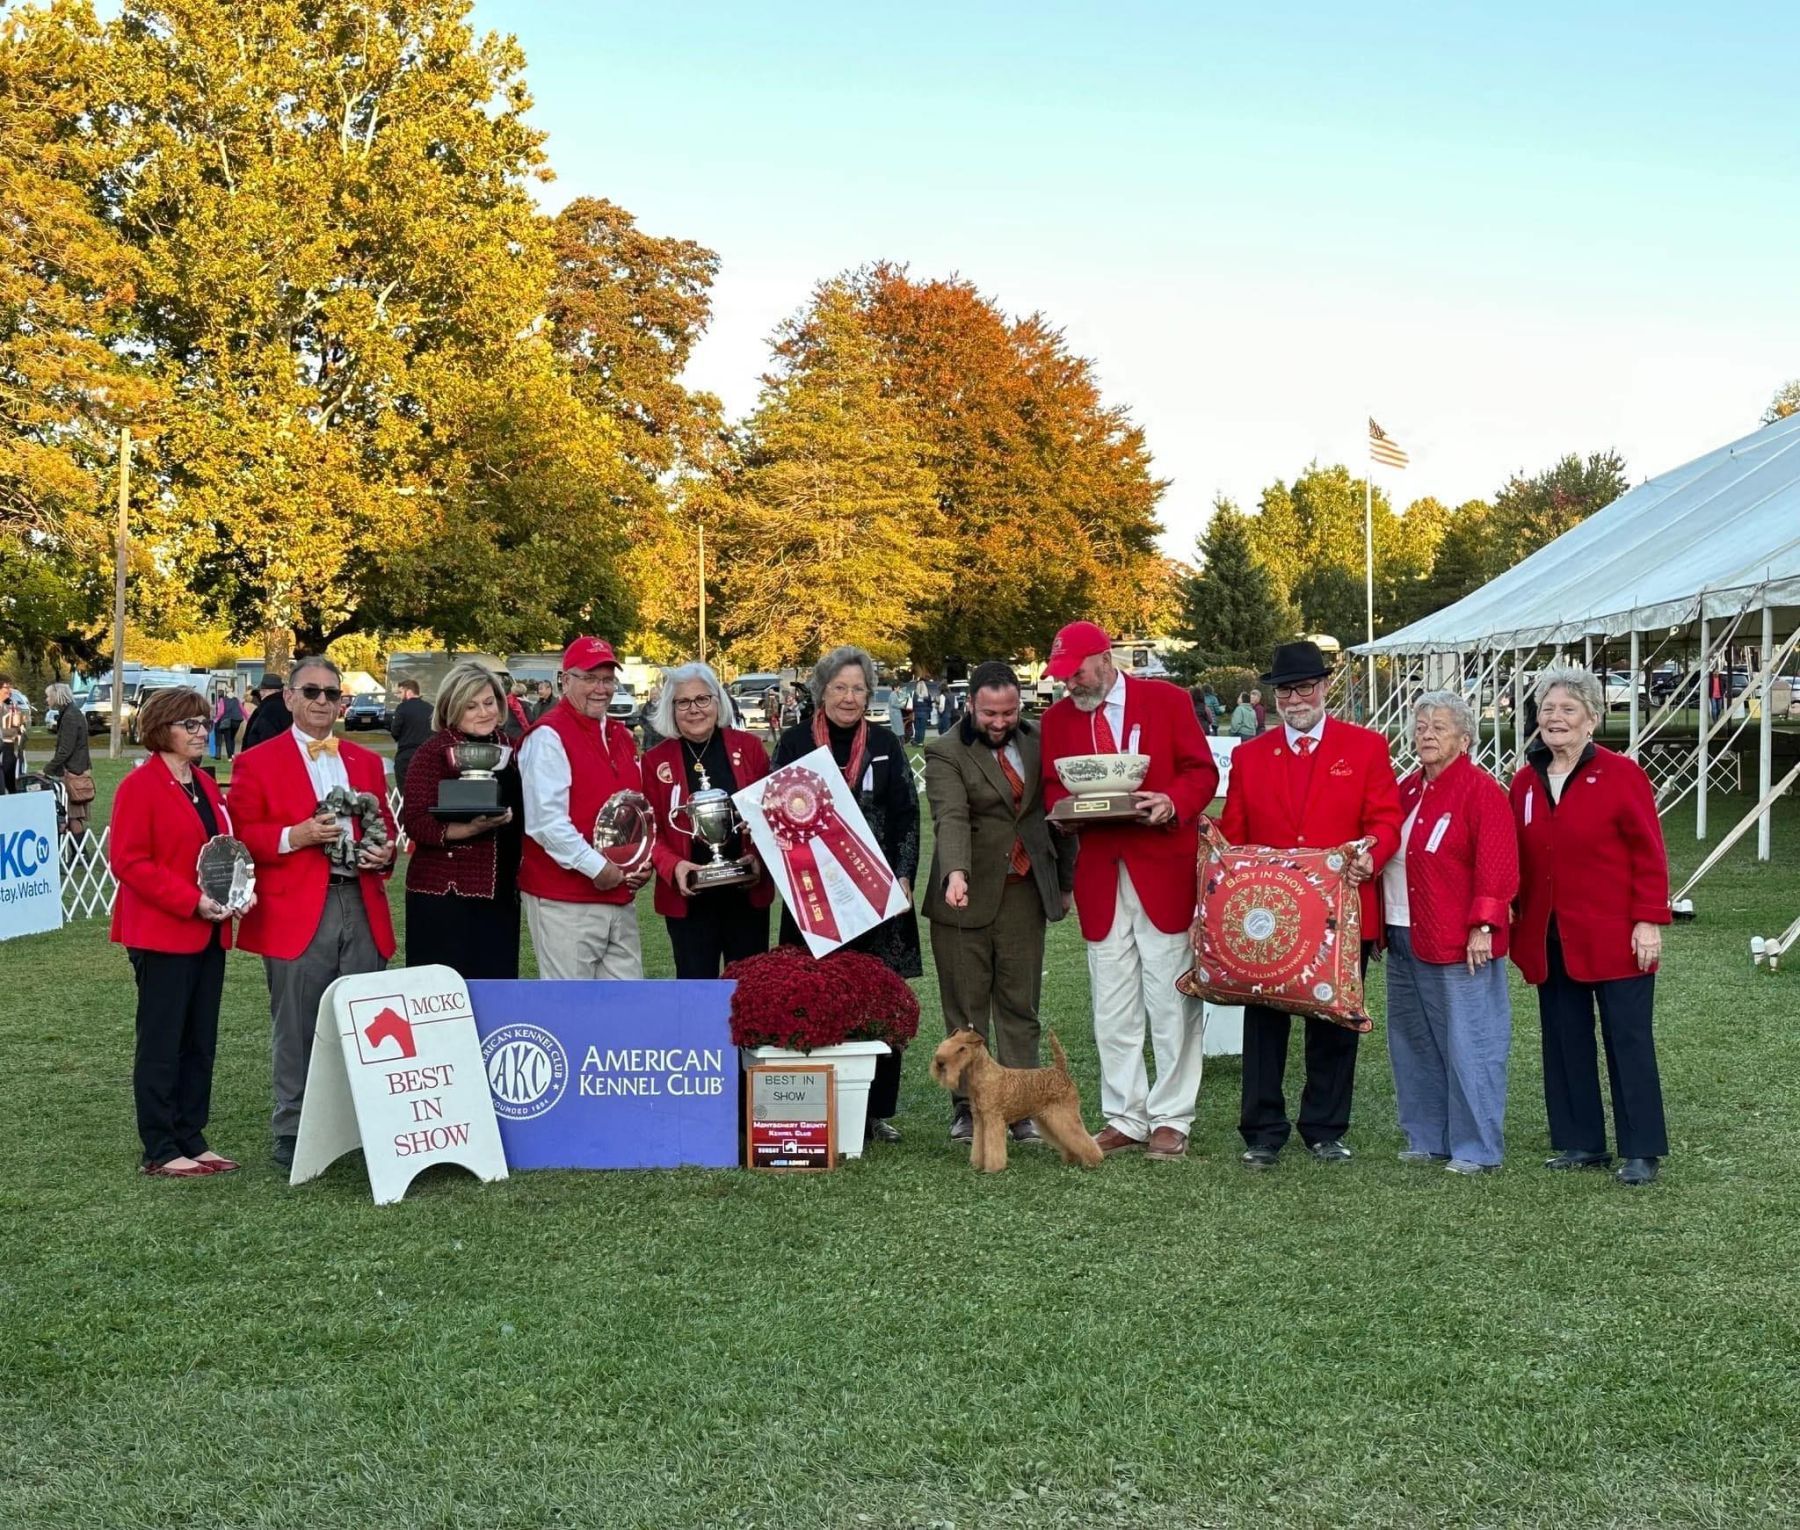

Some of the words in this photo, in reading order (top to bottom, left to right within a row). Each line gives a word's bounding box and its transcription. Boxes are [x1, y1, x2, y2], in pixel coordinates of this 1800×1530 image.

[0, 829, 38, 880] KC
[0, 878, 52, 904] tay.Watch.
[1225, 872, 1257, 889] BEST
[1275, 871, 1307, 896] SHOW
[411, 992, 466, 1016] MCKC
[514, 1028, 553, 1052] KENNEL
[551, 1050, 563, 1079] CLUB
[580, 1045, 722, 1072] AMERICAN
[385, 1064, 454, 1095] BEST
[493, 1044, 547, 1101] AKC
[579, 1074, 661, 1096] KENNEL
[667, 1073, 723, 1096] CLUB
[765, 1075, 797, 1085] BEST
[803, 1075, 815, 1086] IN
[409, 1096, 443, 1122] IN
[493, 1099, 528, 1114] OUNDED
[773, 1091, 806, 1101] SHOW
[394, 1122, 471, 1157] SHOW
